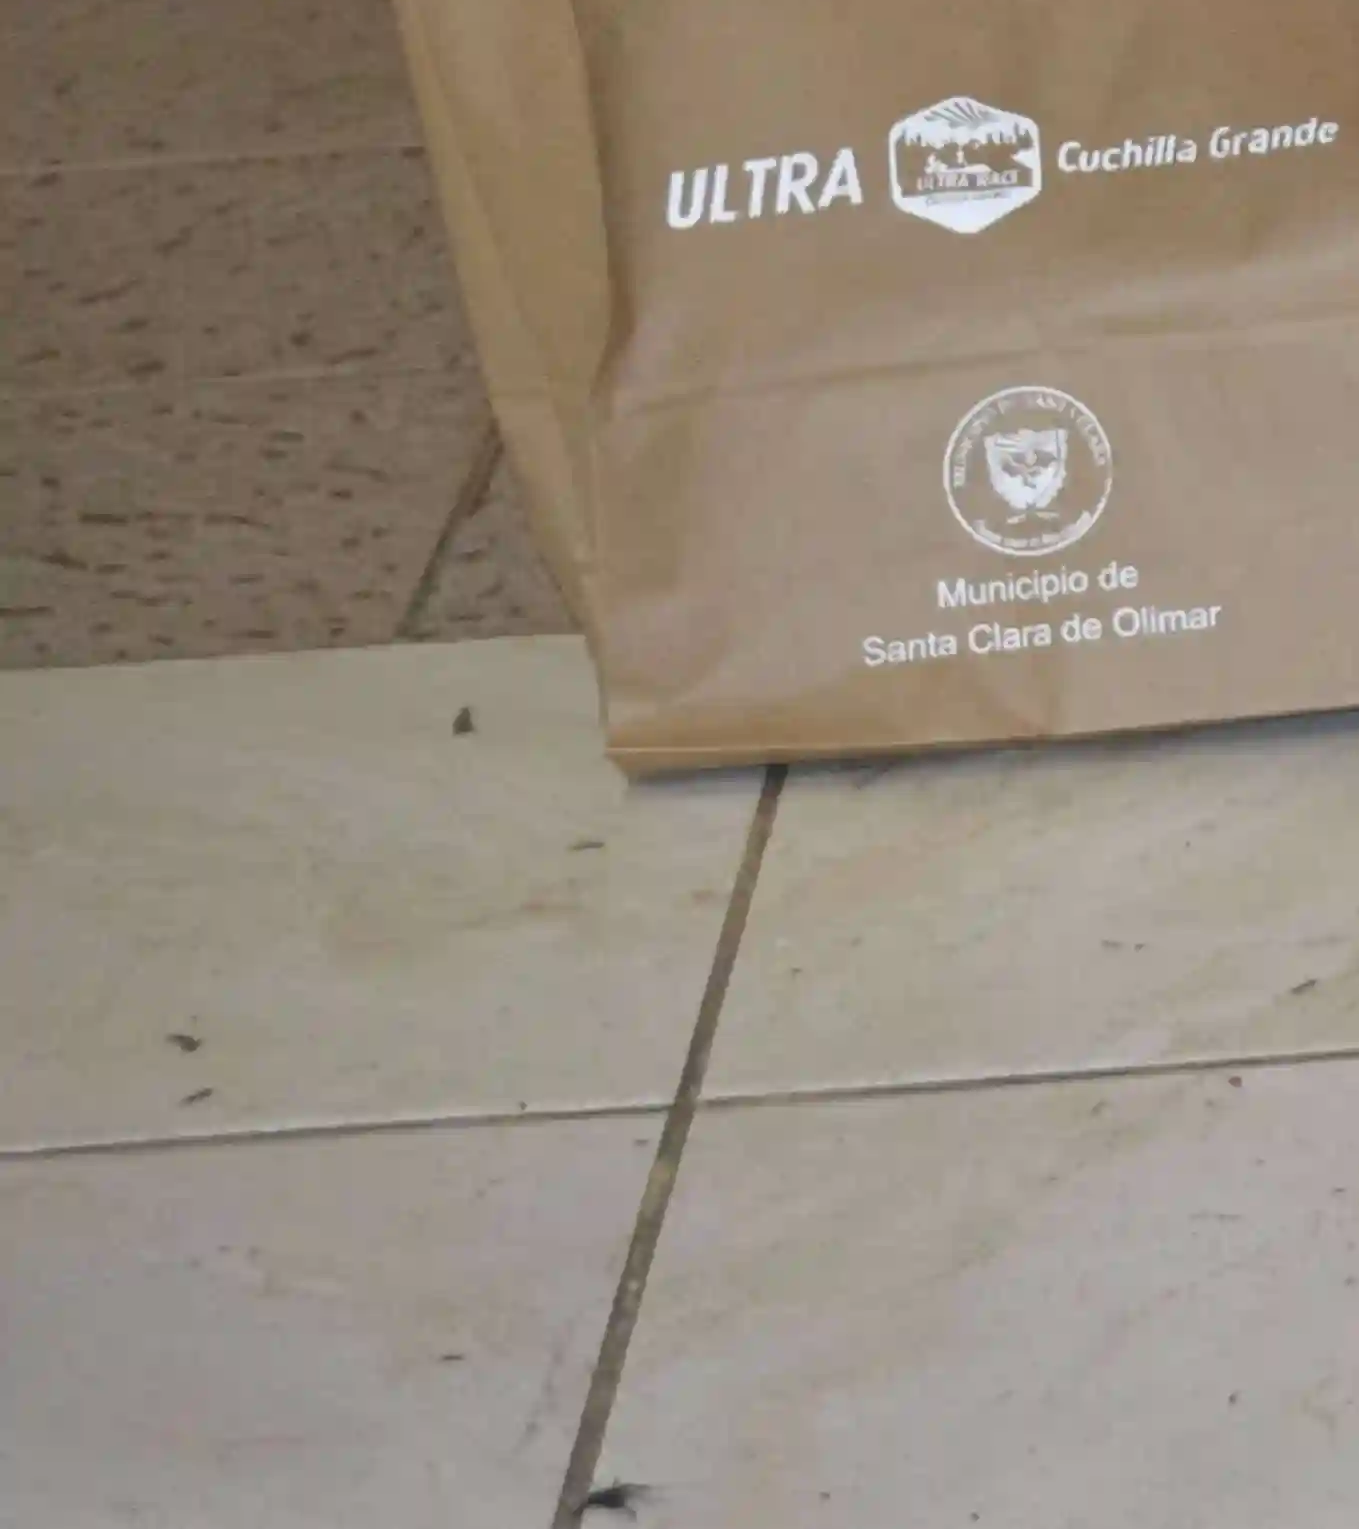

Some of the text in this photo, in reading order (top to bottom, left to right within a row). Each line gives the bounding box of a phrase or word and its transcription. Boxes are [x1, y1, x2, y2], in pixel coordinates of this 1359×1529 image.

[667, 117, 1340, 229] ULTRA Cuchilla Grande
[936, 560, 1139, 608] Municipio de
[862, 605, 1222, 667] Santa Clara de Olimar
